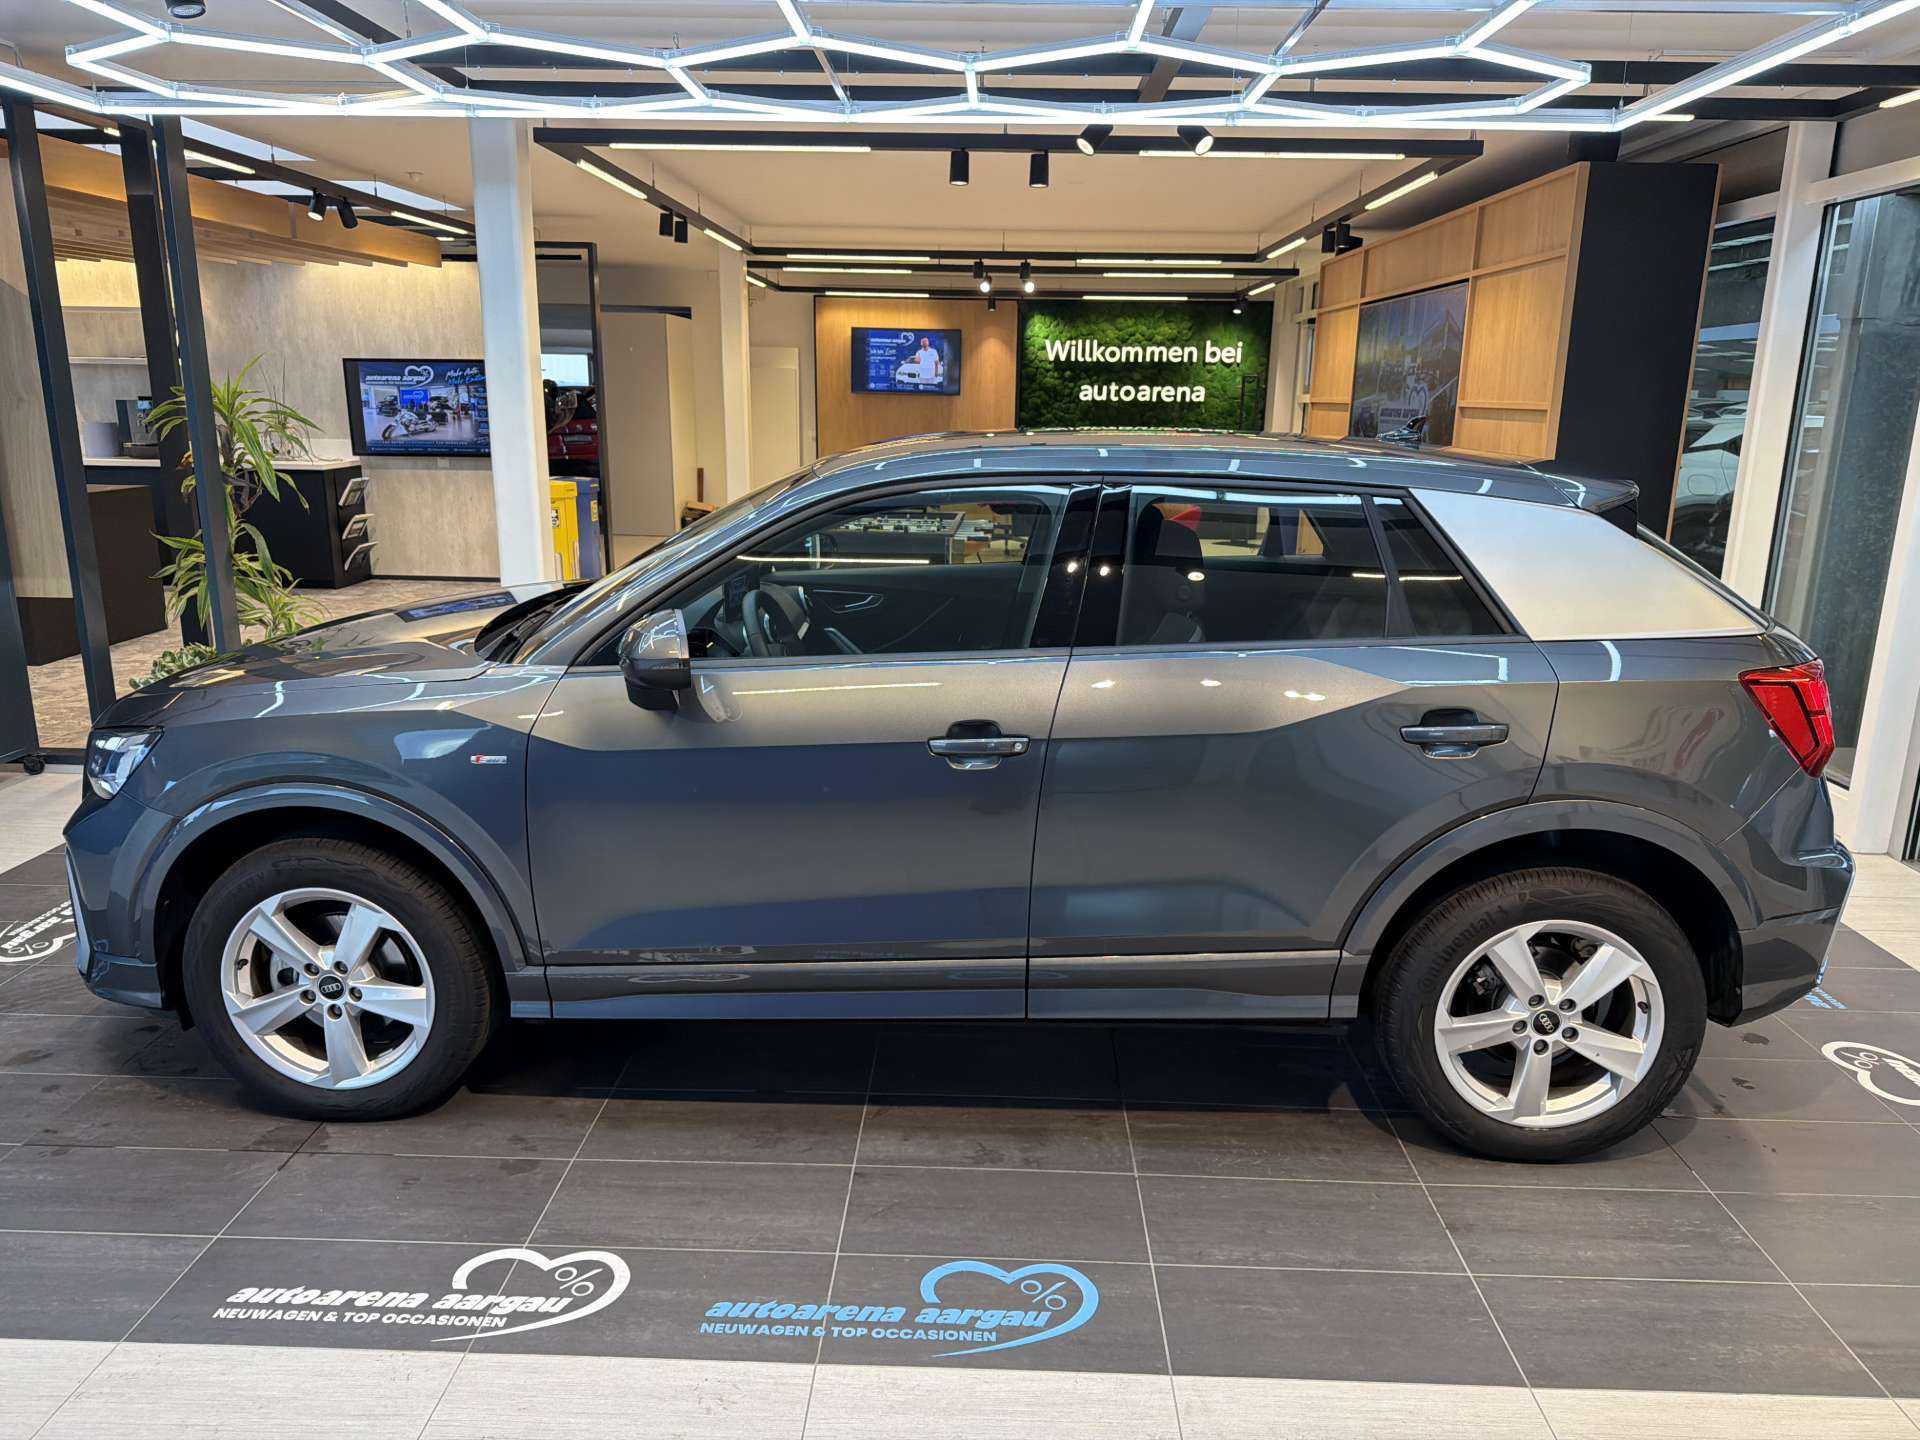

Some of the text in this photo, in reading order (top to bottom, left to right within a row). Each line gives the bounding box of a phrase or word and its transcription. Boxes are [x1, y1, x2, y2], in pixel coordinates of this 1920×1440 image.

[1045, 339, 1243, 365] Willkommen bei
[1078, 382, 1206, 404] autoarena
[226, 1285, 574, 1315] autoarena aargau
[212, 1307, 507, 1328] NEUWAGEN & TOP OCCASIONEN
[704, 1300, 1053, 1329] autoarena aargau
[700, 1323, 997, 1343] NEUWAGEN & TOP OCCASIONEN
